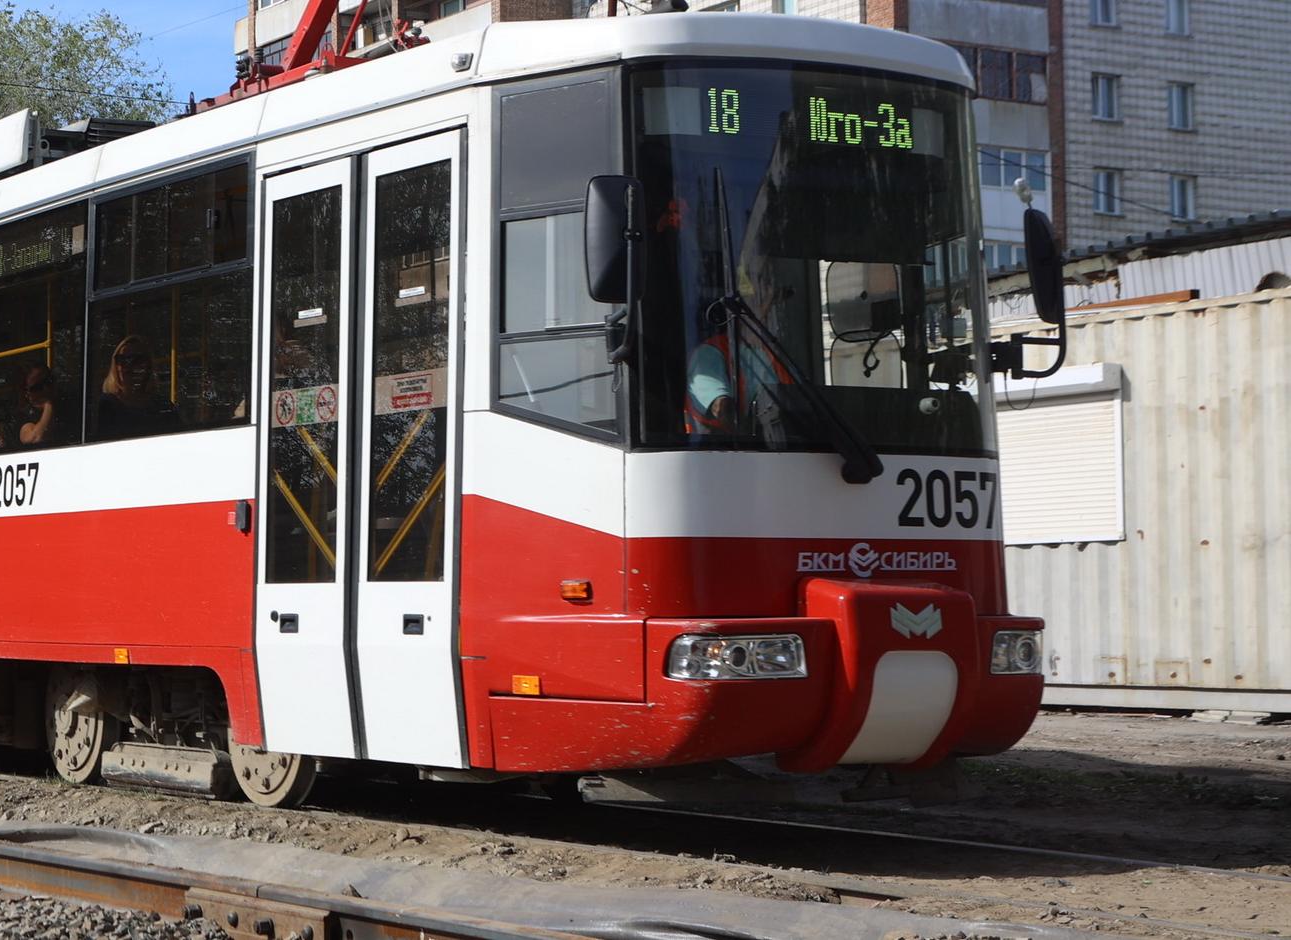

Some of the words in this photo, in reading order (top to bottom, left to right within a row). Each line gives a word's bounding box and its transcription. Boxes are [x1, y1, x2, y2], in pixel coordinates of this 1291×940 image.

[708, 88, 739, 134] 18
[809, 97, 912, 148] Юго-За
[896, 468, 997, 529] 2057
[796, 551, 846, 571] БКМ
[880, 550, 957, 570] СИБИРЬ
